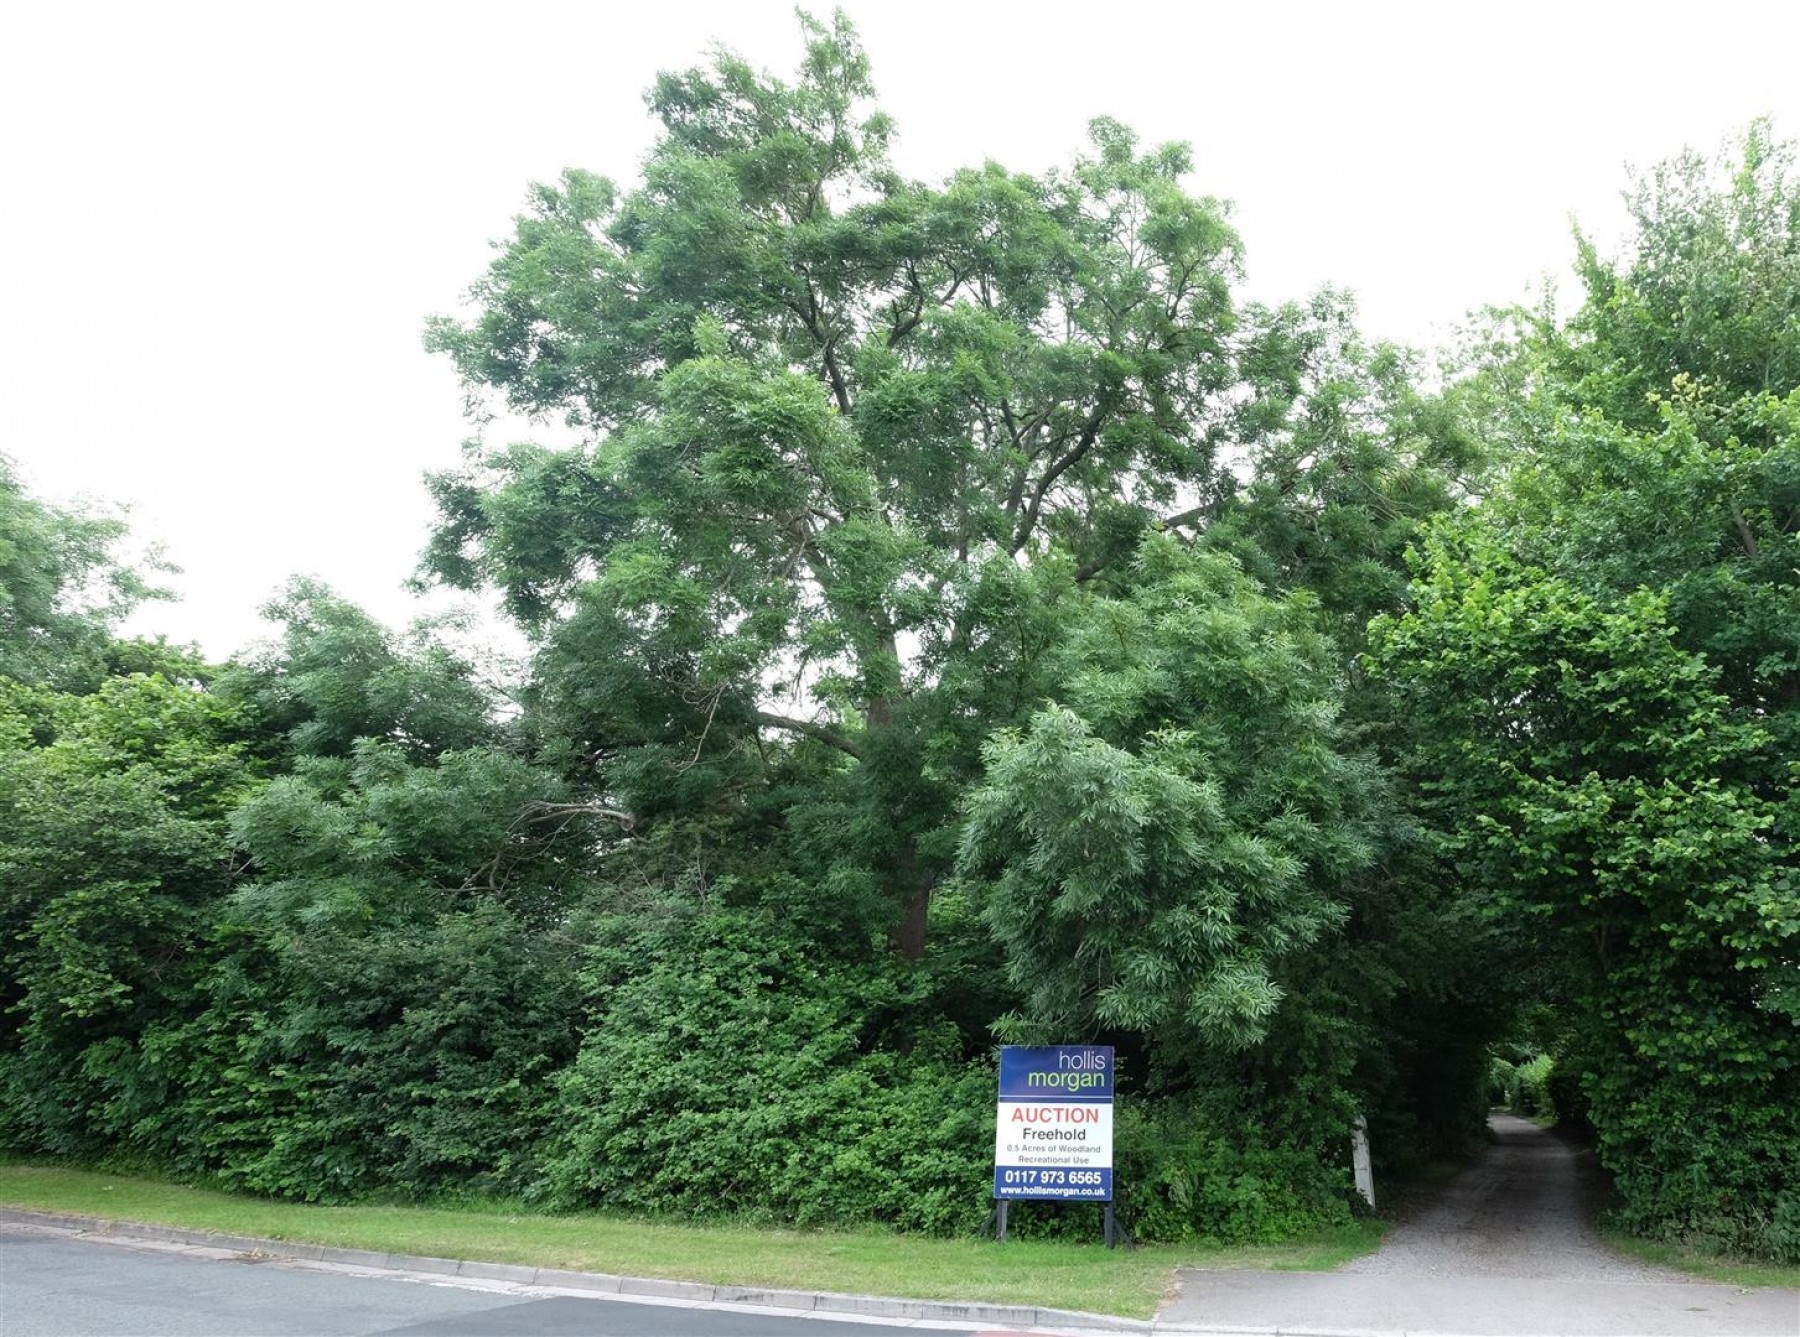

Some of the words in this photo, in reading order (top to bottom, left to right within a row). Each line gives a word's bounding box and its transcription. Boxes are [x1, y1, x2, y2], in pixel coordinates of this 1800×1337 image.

[1059, 1051, 1105, 1069] hollis
[1028, 1072, 1104, 1091] morgan
[1012, 1108, 1098, 1123] AUCTION
[1023, 1128, 1086, 1140] Freehold
[1006, 1170, 1034, 1183] 0117
[1041, 1171, 1065, 1183] 973
[1069, 1172, 1101, 1184] 6565
[1000, 1186, 1105, 1196] www.hollismorgan.co.uk
